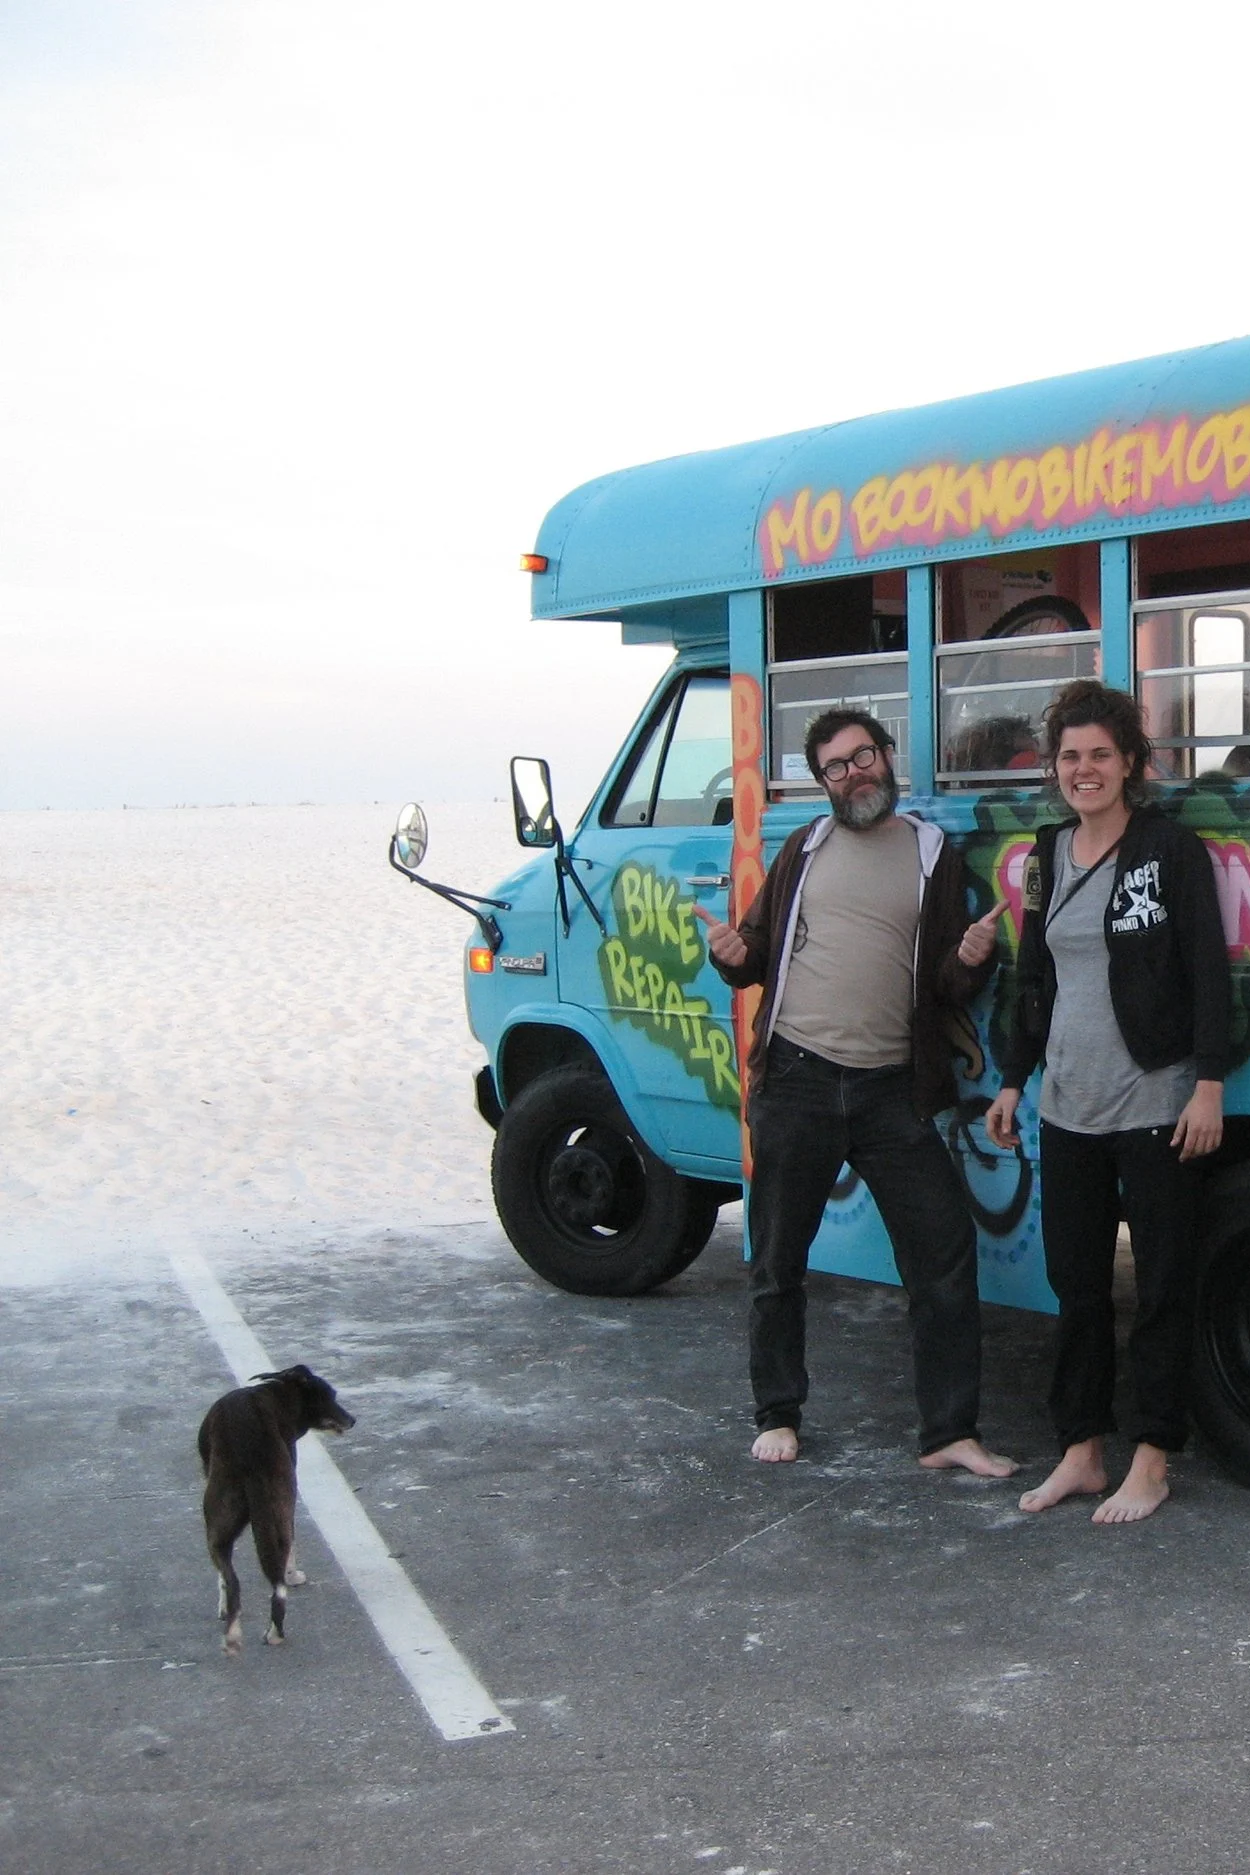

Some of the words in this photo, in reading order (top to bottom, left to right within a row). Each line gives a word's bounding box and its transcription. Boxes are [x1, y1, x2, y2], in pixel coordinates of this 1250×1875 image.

[621, 867, 699, 964] BIKE
[1112, 916, 1139, 933] PINKO
[605, 939, 742, 1093] REPAIR
